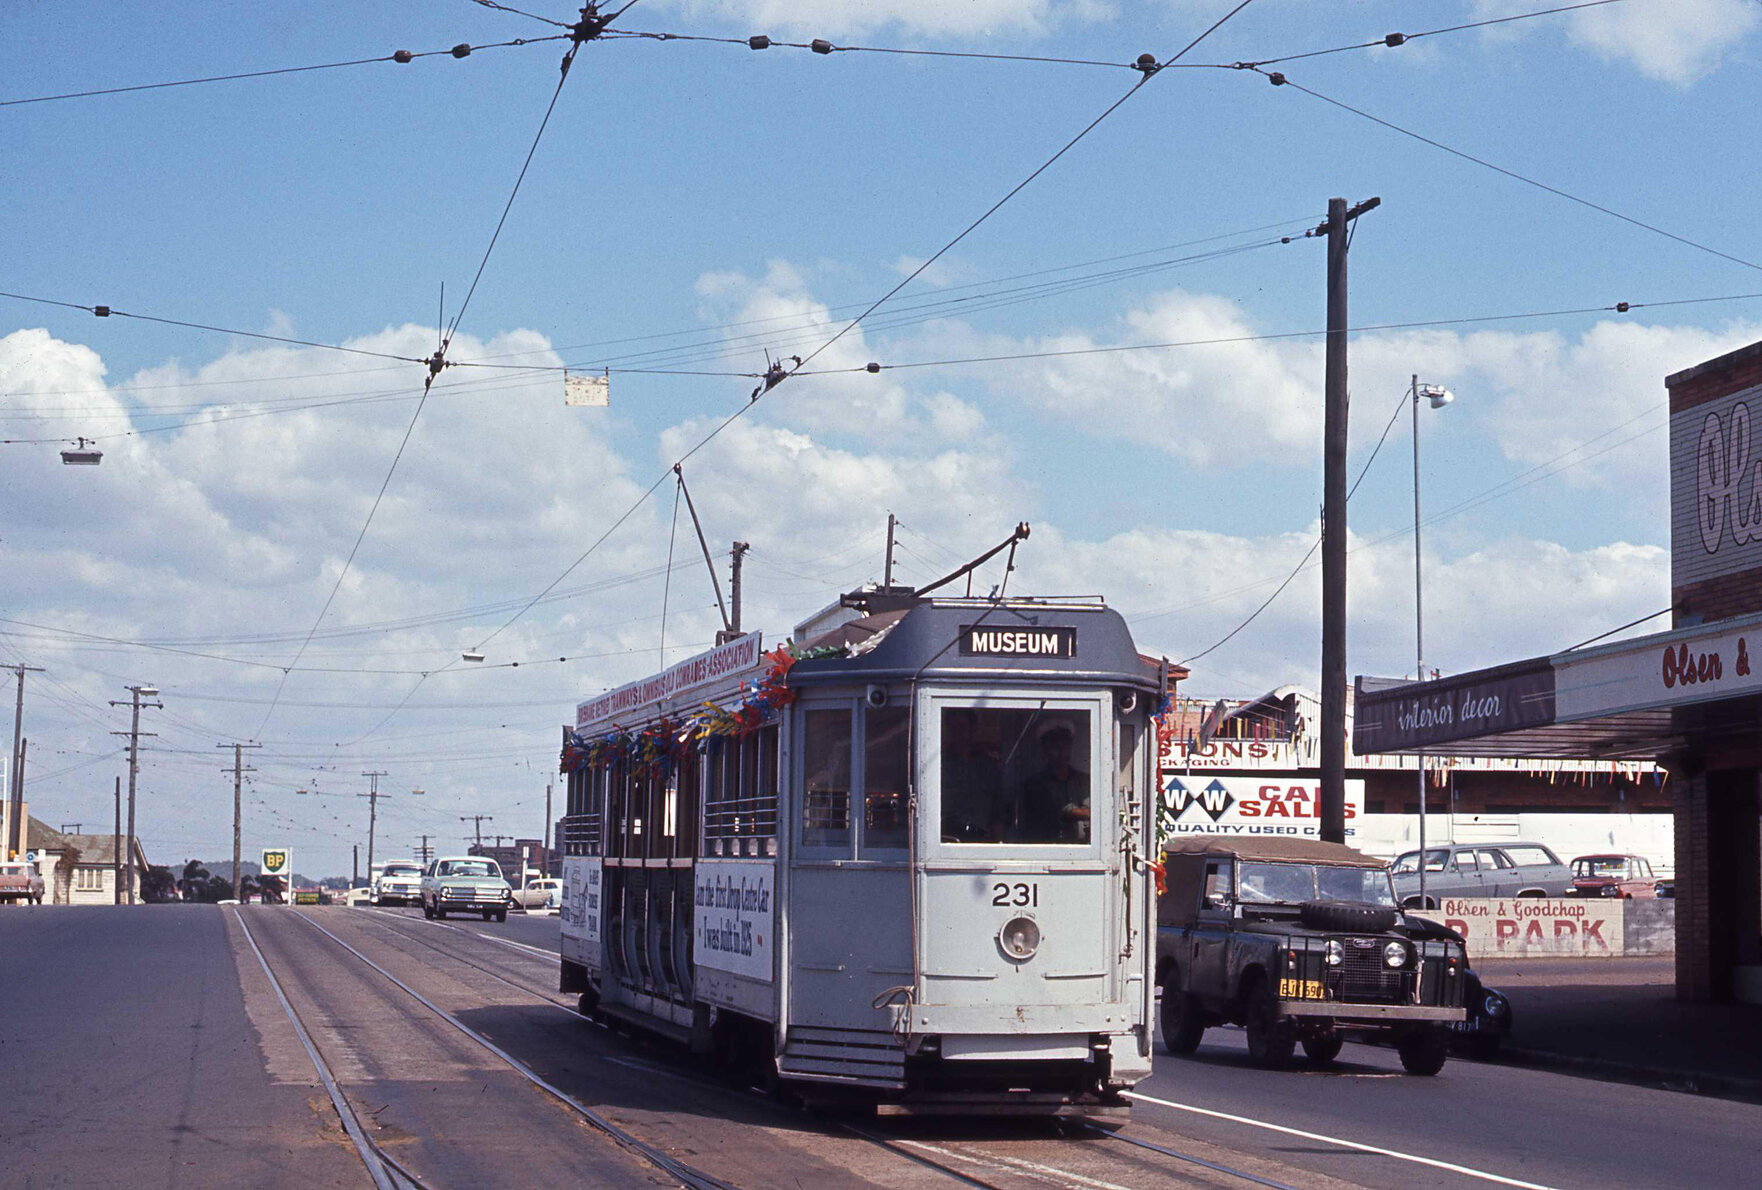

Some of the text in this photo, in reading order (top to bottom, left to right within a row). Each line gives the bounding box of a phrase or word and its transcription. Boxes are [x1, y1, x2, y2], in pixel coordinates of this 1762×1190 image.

[972, 632, 1058, 654] MUSEUM
[708, 640, 755, 677] ASSOCIATION
[1663, 637, 1751, 689] Olsen &
[1397, 690, 1503, 731] interior decor
[1165, 823, 1356, 836] QUALITY USED CS
[267, 854, 284, 868] BP
[992, 882, 1038, 908] 231
[1445, 899, 1586, 922] Olsen & Goodchap
